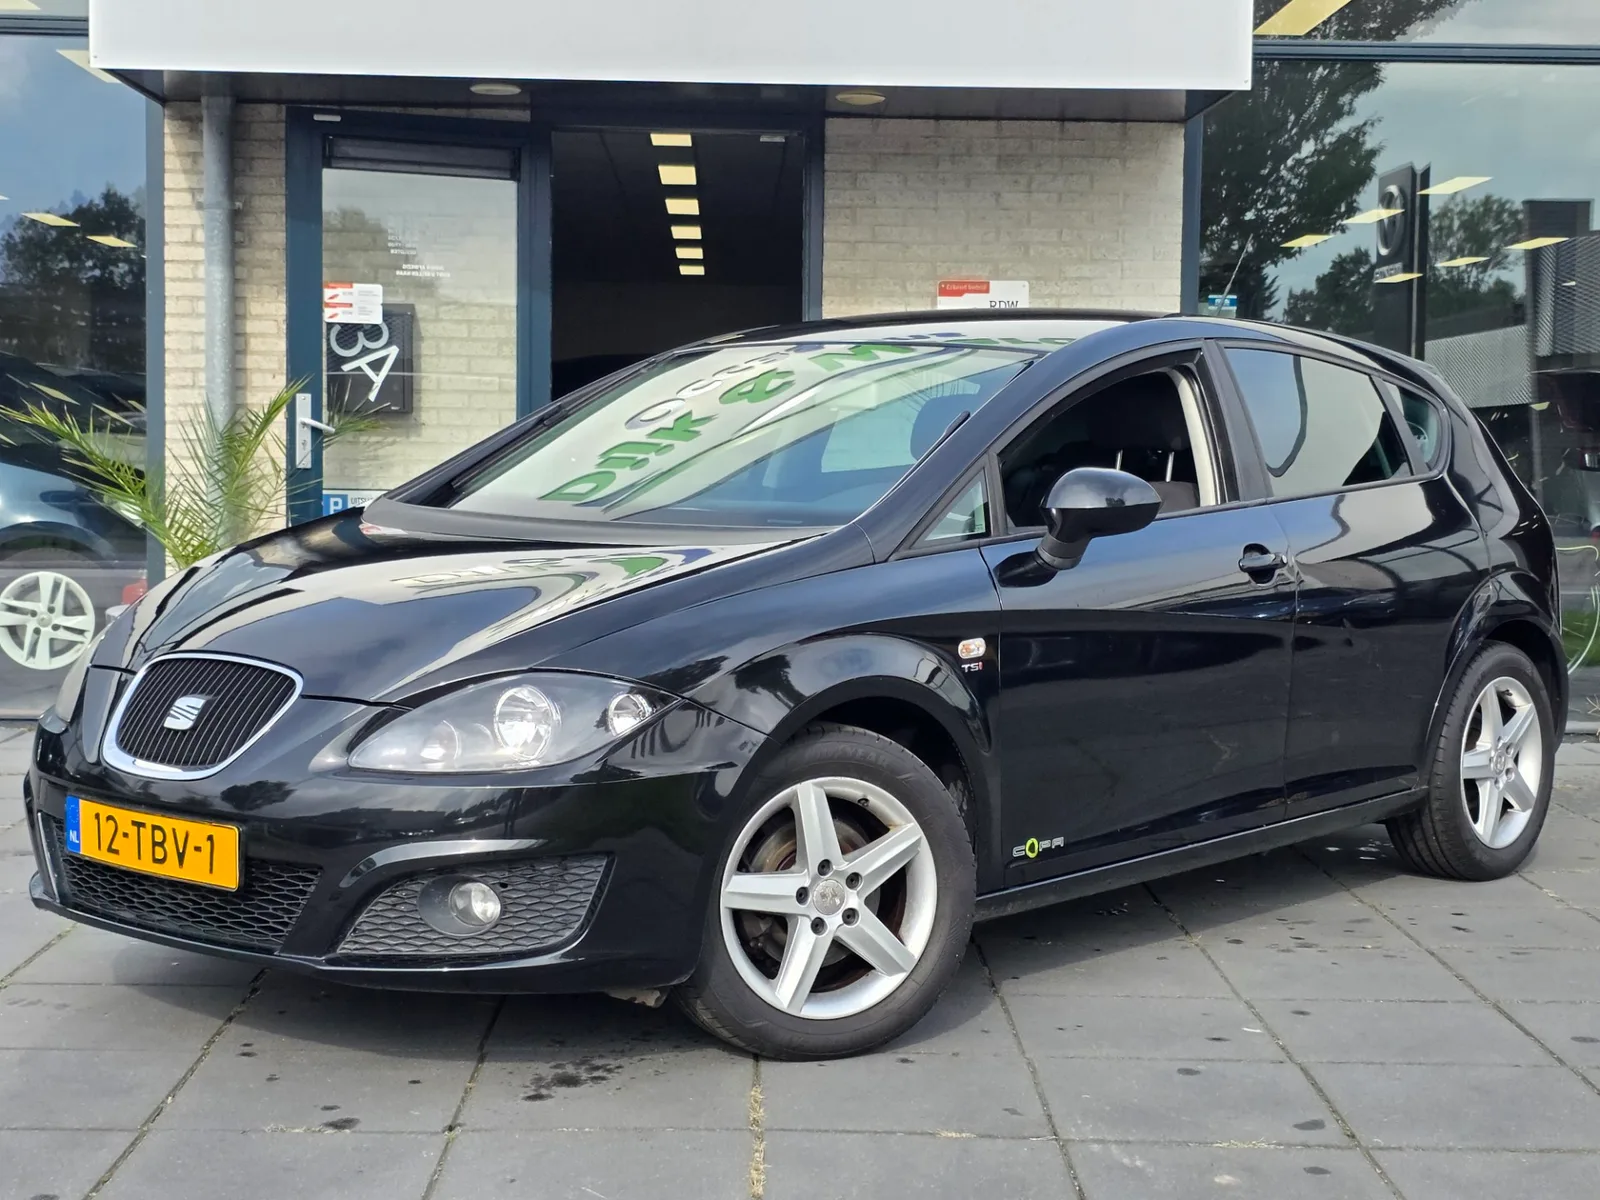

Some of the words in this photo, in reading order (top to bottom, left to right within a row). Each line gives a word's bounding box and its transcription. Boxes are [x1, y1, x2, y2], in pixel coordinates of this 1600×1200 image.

[69, 830, 80, 843] NL
[94, 812, 215, 875] 12-TBV-1
[1012, 836, 1065, 859] COPA
